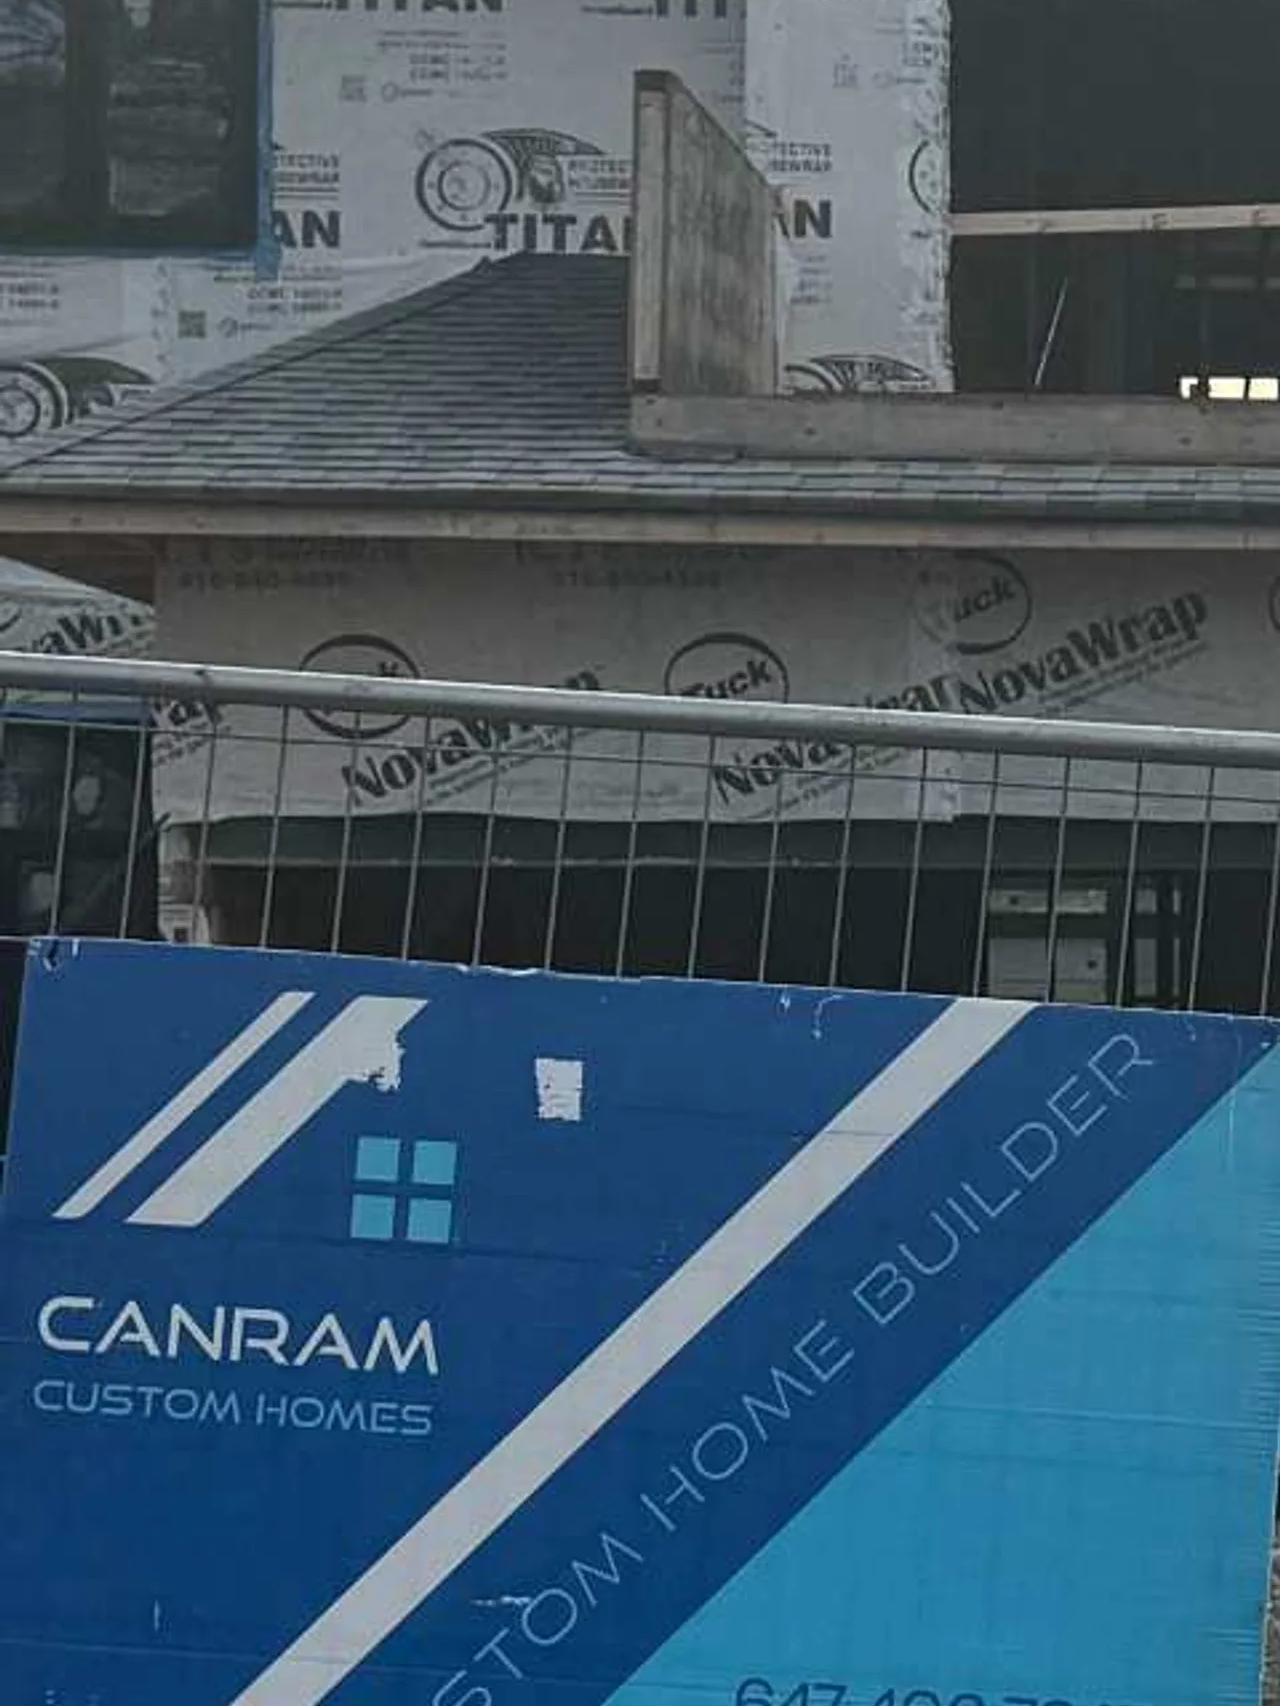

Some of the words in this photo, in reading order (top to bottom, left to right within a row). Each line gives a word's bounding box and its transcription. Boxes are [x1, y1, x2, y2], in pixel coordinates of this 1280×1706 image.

[958, 592, 1208, 714] NovaWrap
[641, 1319, 854, 1532] HOME
[853, 1033, 1153, 1326] BUILDER
[37, 1296, 439, 1375] CANRAM
[33, 1379, 241, 1425] CUSTOM
[256, 1394, 433, 1436] HOMES
